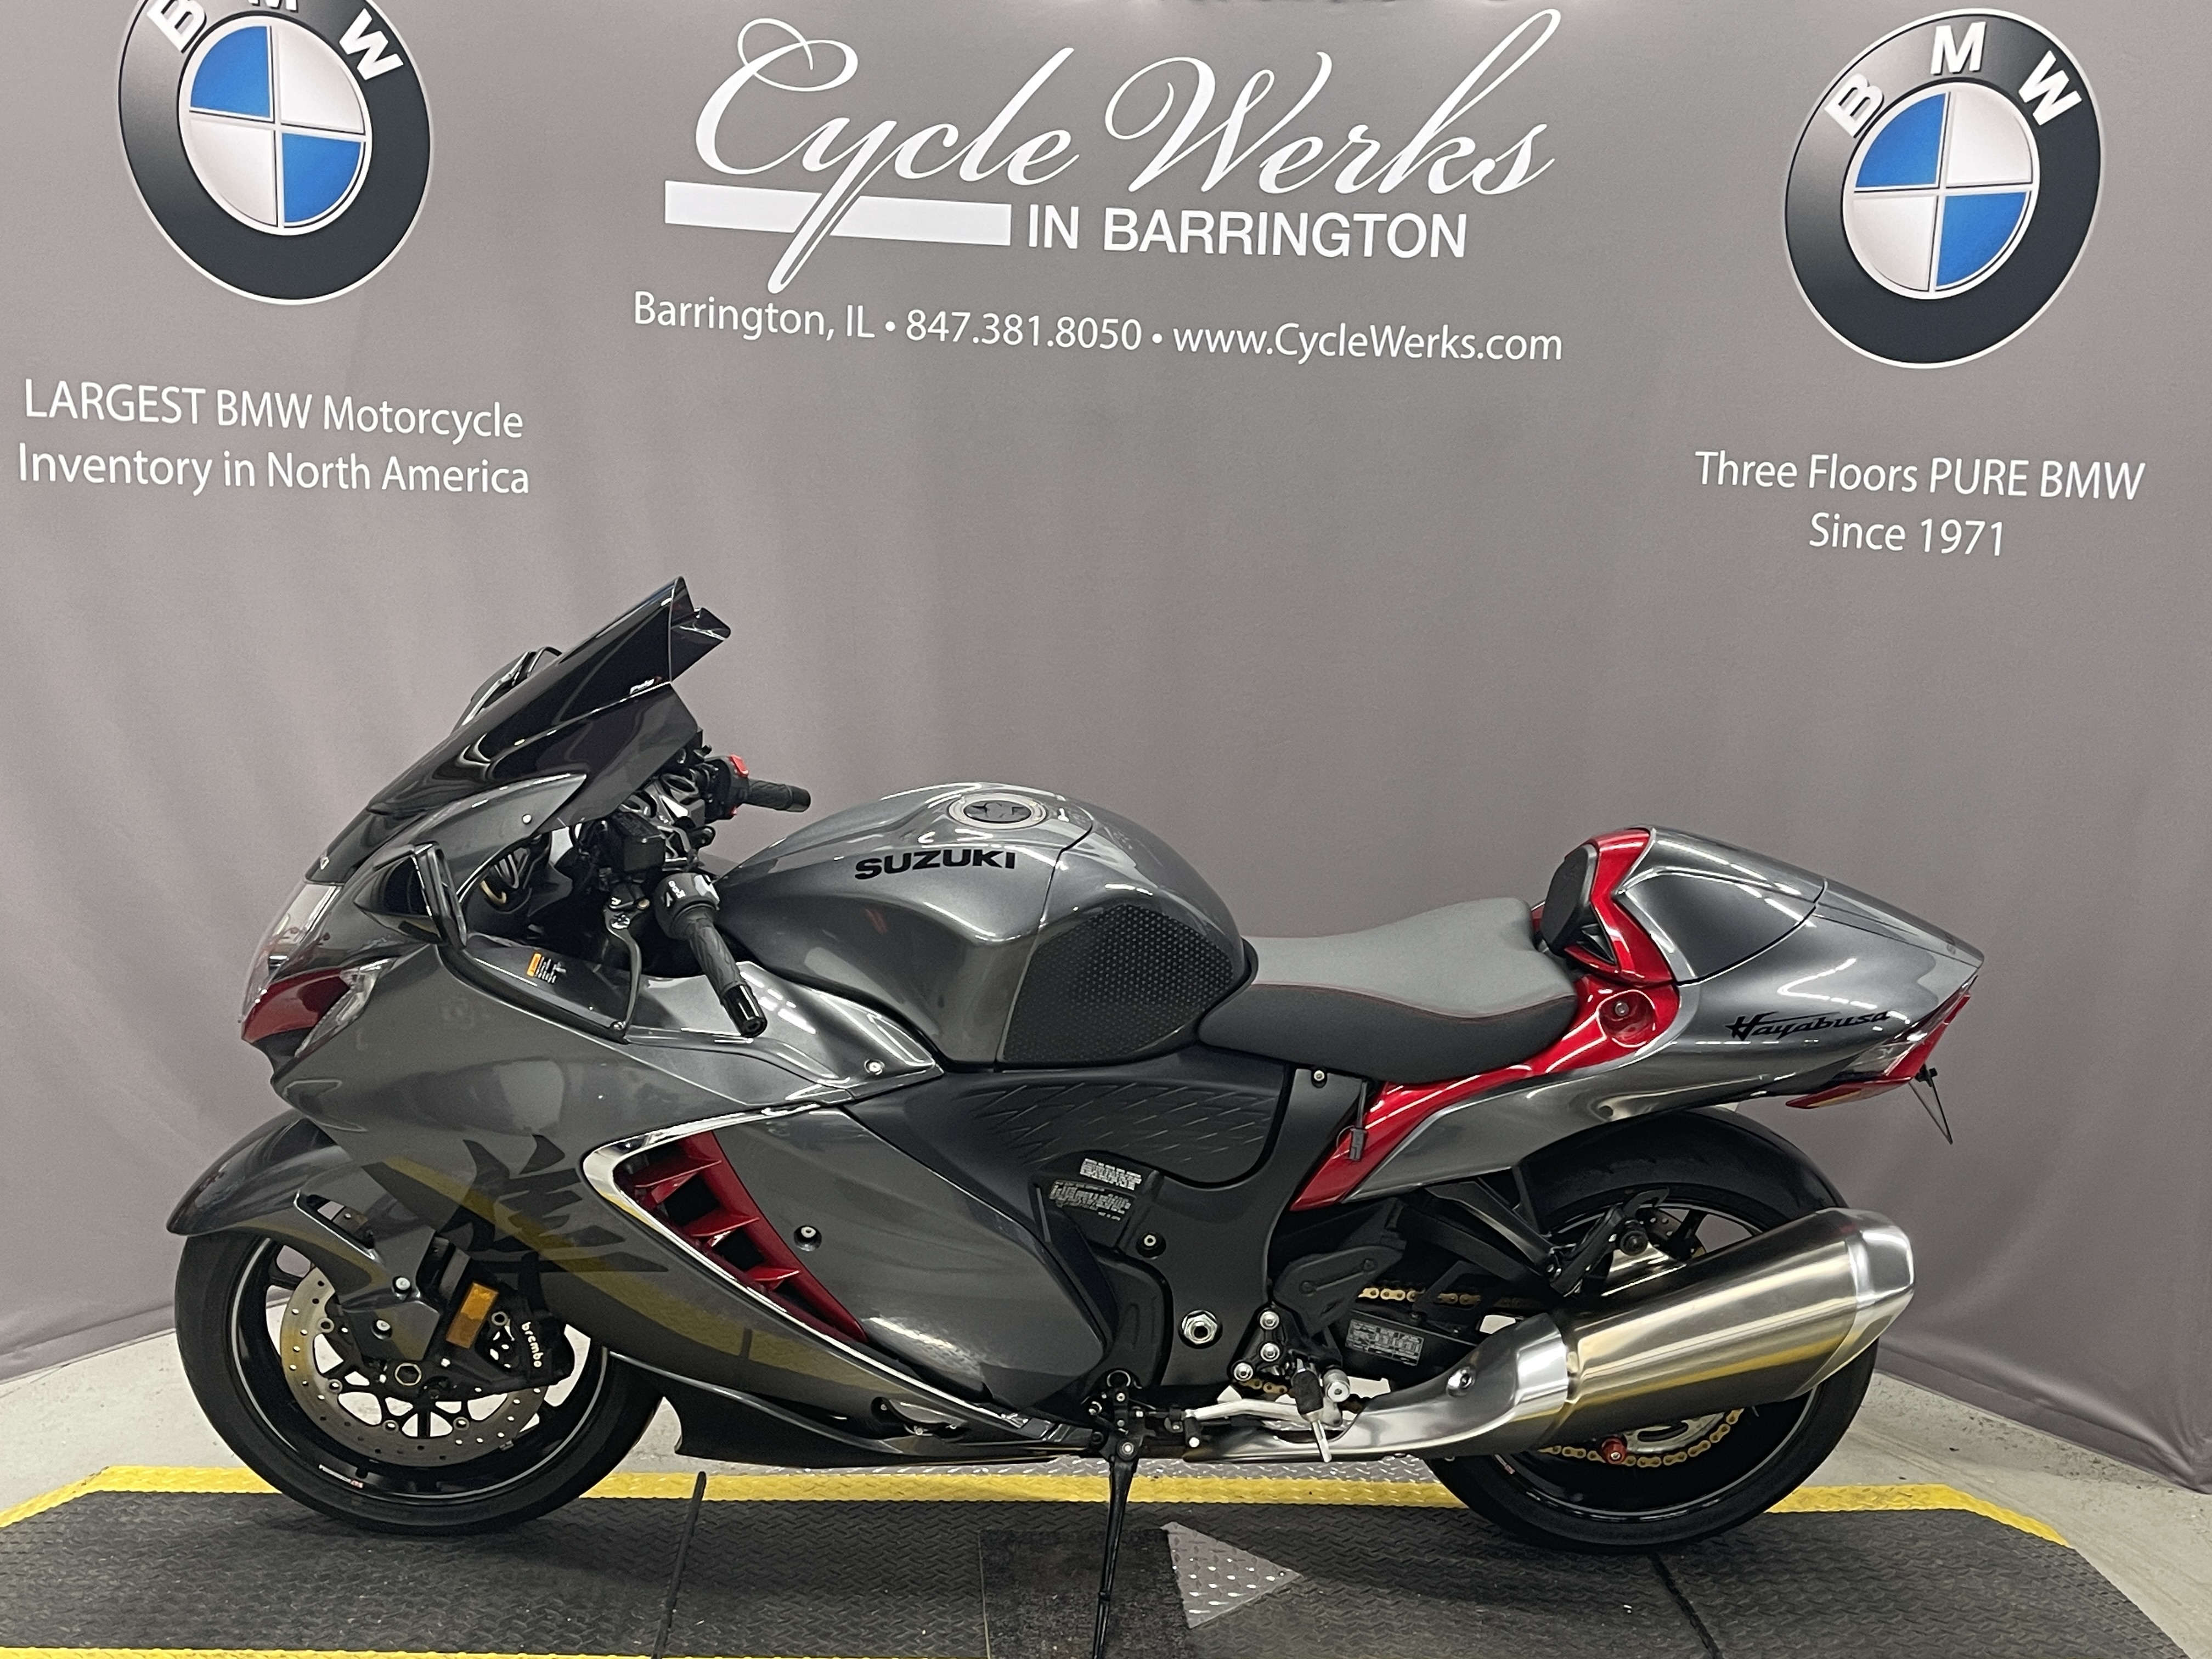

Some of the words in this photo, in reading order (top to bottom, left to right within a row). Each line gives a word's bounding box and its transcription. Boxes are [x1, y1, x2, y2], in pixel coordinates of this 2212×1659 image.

[146, 0, 403, 80] BW
[1824, 21, 2081, 137] BMW
[696, 18, 1080, 294] Cycle
[1105, 9, 1561, 195] Werks
[1029, 204, 1079, 249] IN
[1104, 207, 1466, 258] BARRINGTON
[635, 291, 834, 341] Barrington,
[847, 304, 875, 338] IL
[906, 309, 1142, 350] 847.381.8050
[1173, 323, 1562, 365] www.CycleWerks.com
[26, 379, 206, 424] LARGEST
[217, 389, 312, 429] BMW
[324, 395, 523, 445] Motorcycle
[20, 443, 213, 496] Inventory
[223, 450, 255, 487] in
[268, 452, 370, 489] North
[381, 456, 528, 494] America
[1695, 450, 1797, 488] Three
[1809, 453, 1917, 492] Floors
[1930, 458, 2029, 496] PURE
[2040, 460, 2146, 500] BMW
[1809, 512, 1905, 551] Since
[1921, 518, 2002, 556] 1971
[854, 849, 1015, 881] SUZUKI
[1724, 1011, 1891, 1042] Hayabusa
[521, 1321, 544, 1368] brembo
